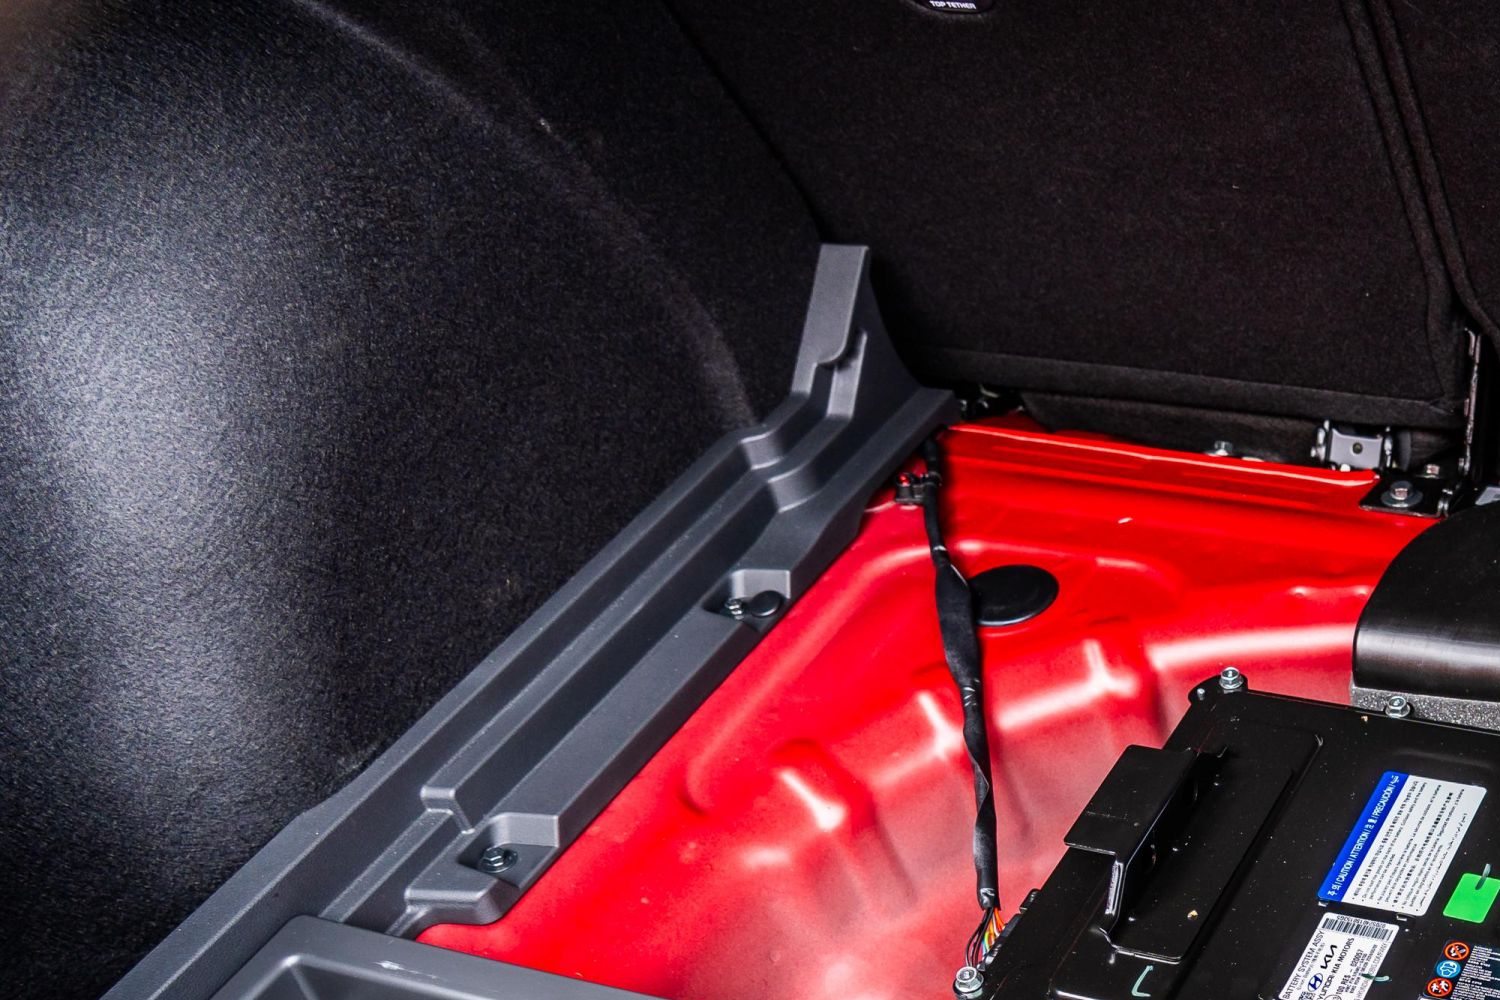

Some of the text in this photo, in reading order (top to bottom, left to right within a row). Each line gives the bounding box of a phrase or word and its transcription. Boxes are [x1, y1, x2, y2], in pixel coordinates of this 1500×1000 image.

[1336, 861, 1353, 882] CAUTION
[1282, 974, 1300, 998] BATTERY
[1298, 948, 1315, 972] SYSTEM
[1312, 931, 1324, 948] ASSY
[1331, 963, 1341, 973] KIA
[1339, 938, 1354, 962] MOTORS
